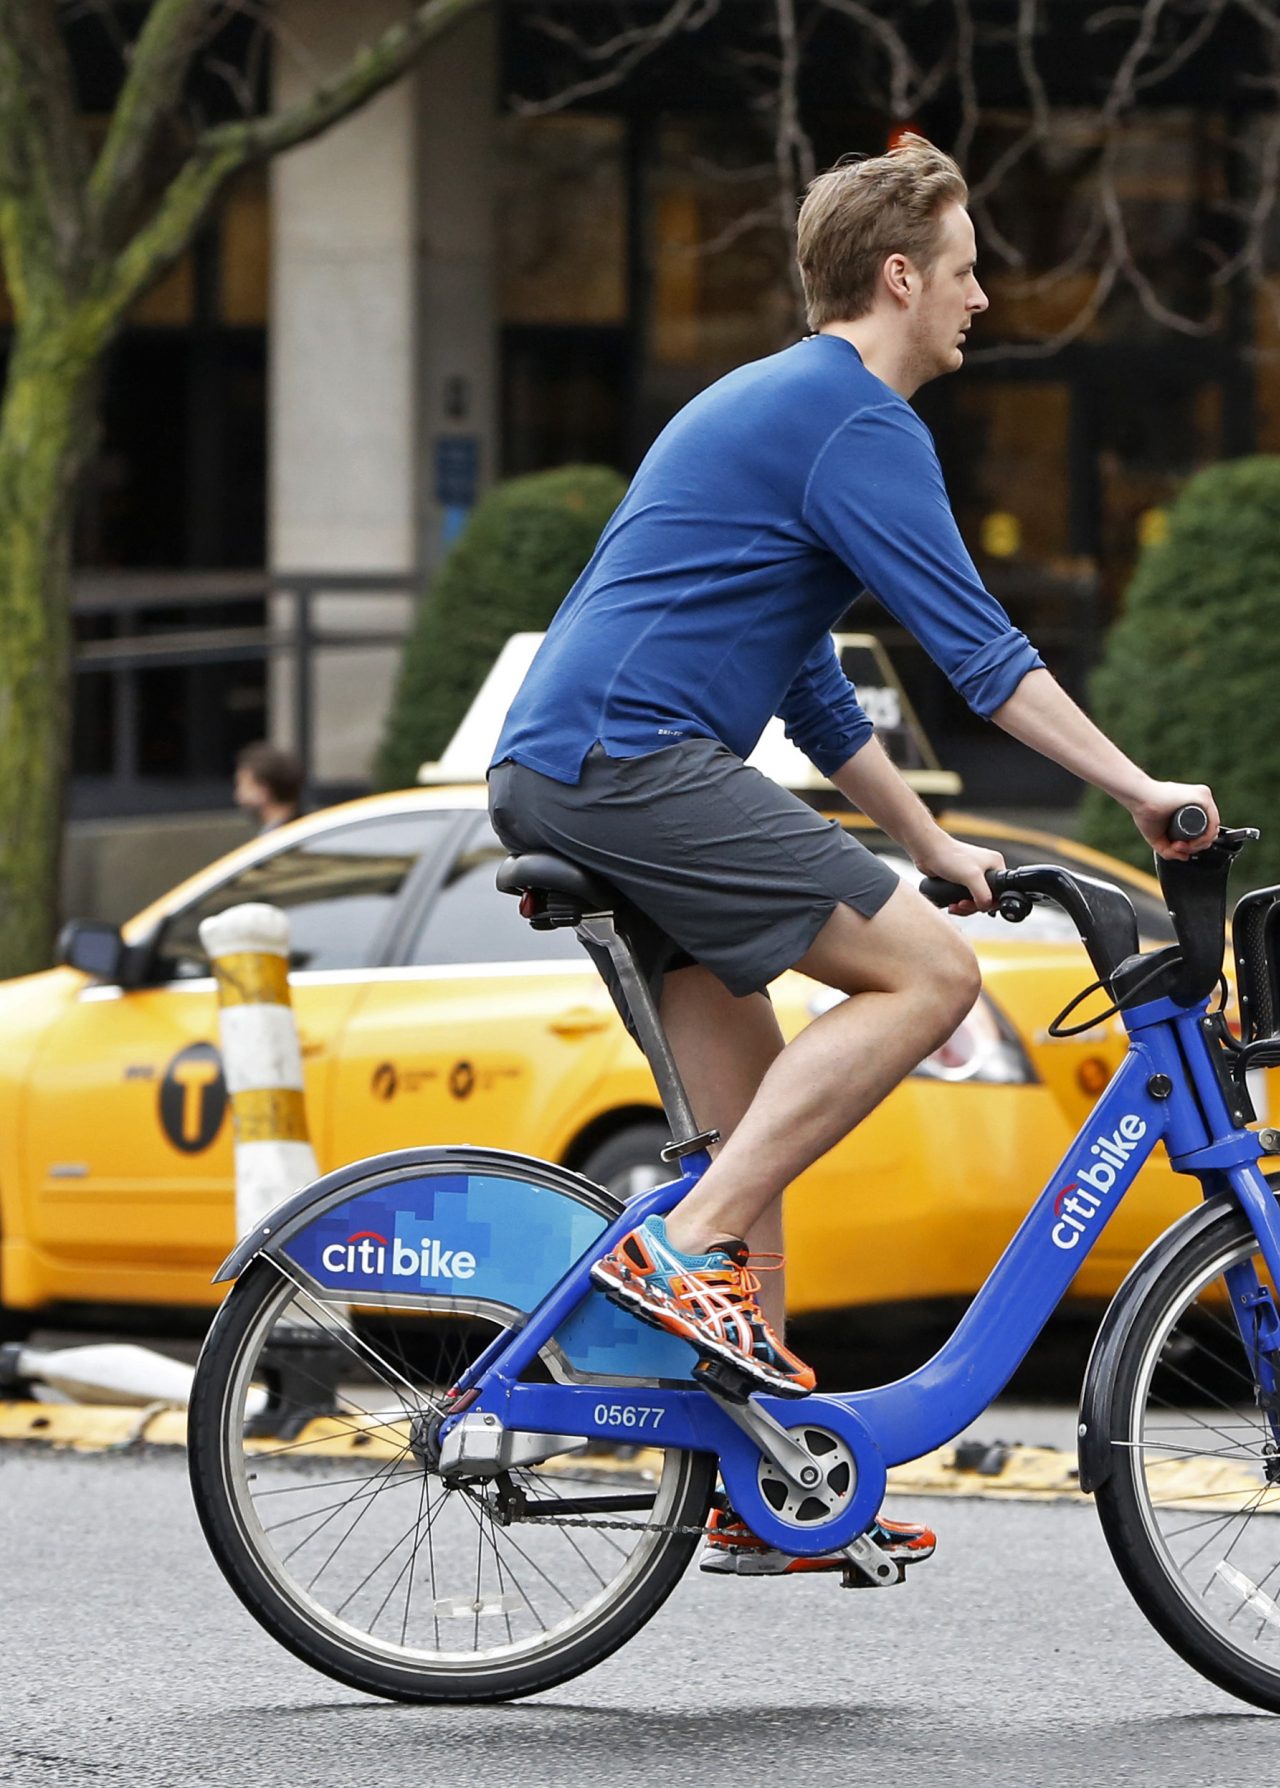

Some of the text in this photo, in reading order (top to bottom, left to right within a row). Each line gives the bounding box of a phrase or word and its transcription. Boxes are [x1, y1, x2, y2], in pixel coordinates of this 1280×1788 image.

[1051, 1114, 1147, 1250] citi bike
[321, 1231, 477, 1280] citi bike
[594, 1404, 665, 1428] 05677
